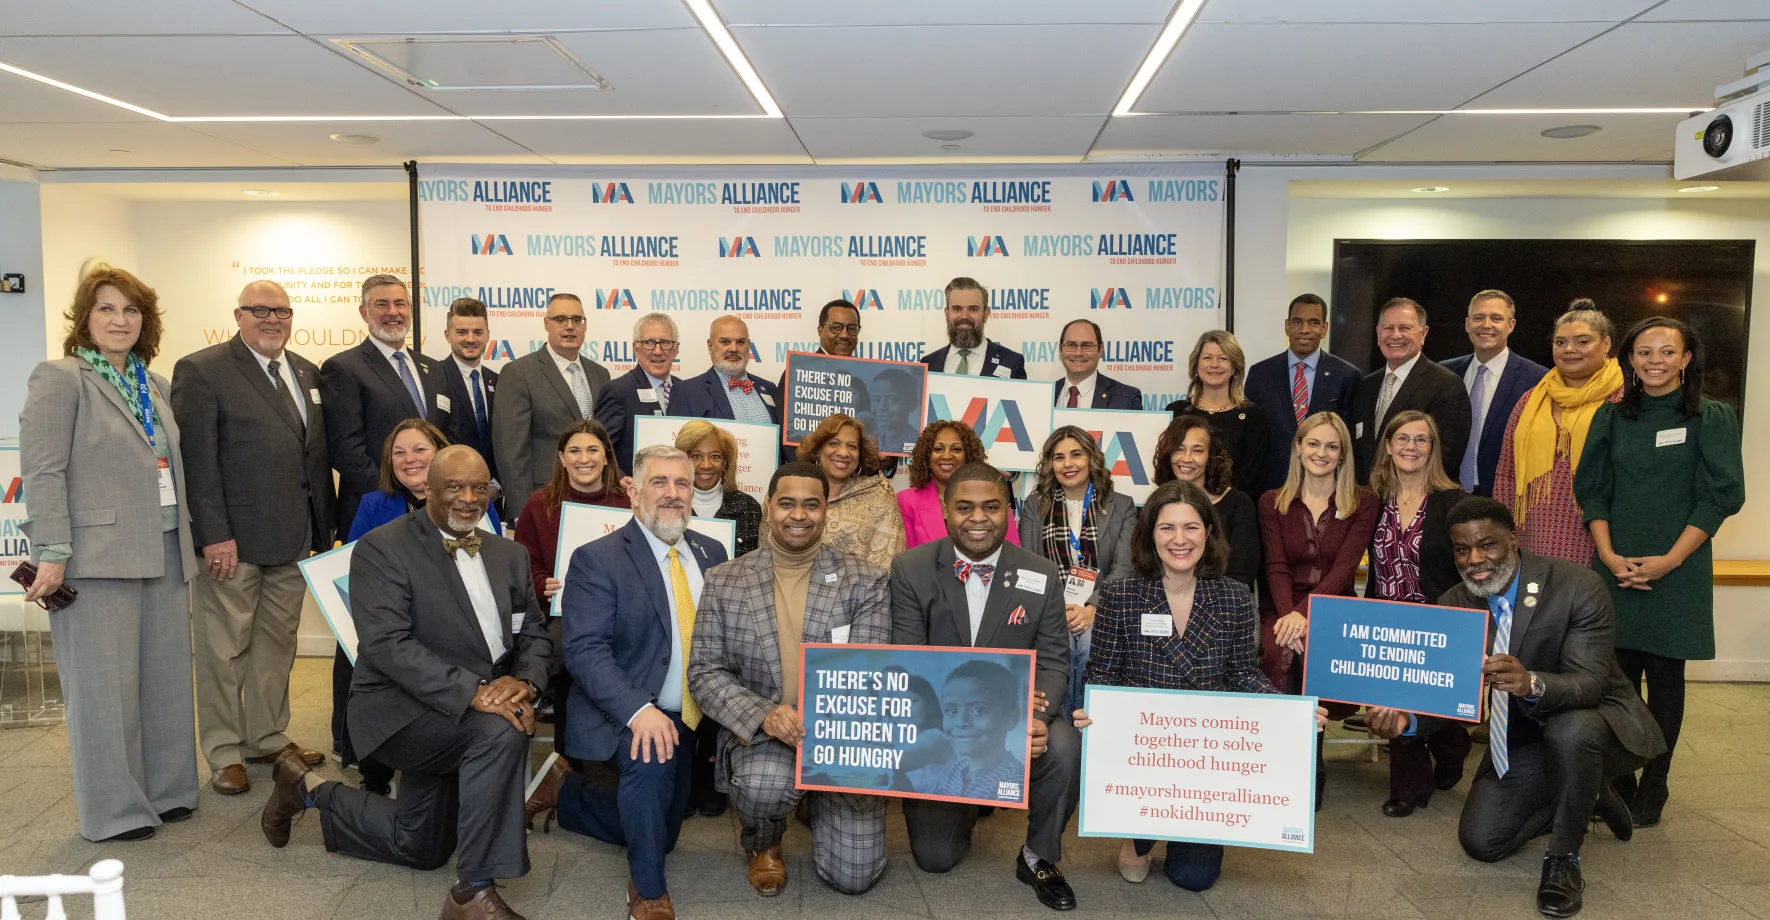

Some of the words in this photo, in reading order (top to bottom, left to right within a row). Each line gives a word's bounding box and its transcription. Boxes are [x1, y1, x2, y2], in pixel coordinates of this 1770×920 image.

[418, 180, 469, 202] AYORS
[473, 181, 552, 203] ALLIANCE
[648, 182, 717, 205] MAYORS
[721, 182, 801, 205] ALLIANCE
[897, 181, 967, 204] MAYORS
[971, 181, 1052, 204] ALLIANCE
[1148, 179, 1218, 203] MAYORS
[526, 234, 596, 257] MAYORS
[600, 235, 679, 258] ALLIANCE
[774, 235, 844, 257] MAYORS
[847, 235, 927, 258] ALLIANCE
[1023, 234, 1094, 257] MAYORS
[1097, 233, 1177, 256] ALLIANCE
[249, 267, 275, 275] TOOK
[278, 267, 296, 275] THE
[298, 267, 335, 275] PLEDGE
[337, 267, 350, 275] SO
[358, 267, 379, 275] CAN
[381, 267, 408, 275] MAKE
[311, 281, 331, 289] AND
[333, 281, 353, 289] FOR
[305, 295, 321, 303] ALL
[330, 295, 350, 303] CAN
[424, 286, 473, 308] AYORS
[651, 288, 720, 311] MAYORS
[724, 289, 801, 311] ALLIANCE
[897, 289, 944, 311] MAYO
[988, 288, 1050, 310] LIANCE
[1145, 287, 1215, 309] MAYORS
[1021, 341, 1060, 363] MAY
[796, 368, 836, 386] THERE'S
[837, 373, 852, 387] NO
[1107, 364, 1113, 372] TO
[1114, 364, 1124, 372] END
[1125, 364, 1153, 372] CHILDHOOD
[1153, 364, 1174, 372] HUNGER
[795, 385, 833, 402] EXCUSE
[833, 389, 853, 404] FOR
[794, 401, 841, 418] CHILDREN
[842, 406, 856, 419] TO
[794, 417, 807, 431] GO
[1342, 623, 1347, 638] I
[1349, 624, 1369, 640] AM
[1372, 626, 1448, 649] COMMITTED
[1361, 643, 1376, 659] TO
[1379, 645, 1426, 665] ENDING
[816, 669, 883, 691] THERE'S
[887, 671, 909, 692] NO
[1330, 659, 1400, 681] CHILDHOOD
[1402, 667, 1455, 689] HUNGER
[815, 694, 877, 717] EXCUSE
[881, 697, 912, 718] FOR
[814, 719, 893, 743] CHILDREN
[897, 723, 918, 744] TO
[1139, 711, 1197, 730] Mayors
[1201, 715, 1260, 735] coming
[1133, 732, 1200, 749] together
[1203, 736, 1219, 750] to
[1222, 737, 1263, 752] solve
[813, 744, 835, 766] GO
[838, 746, 904, 770] HUNGRY
[1127, 751, 1206, 771] childhood
[1210, 755, 1268, 776] hunger
[1104, 782, 1290, 807] #mayorshungeralliance
[1139, 804, 1252, 828] #nokidhungry
